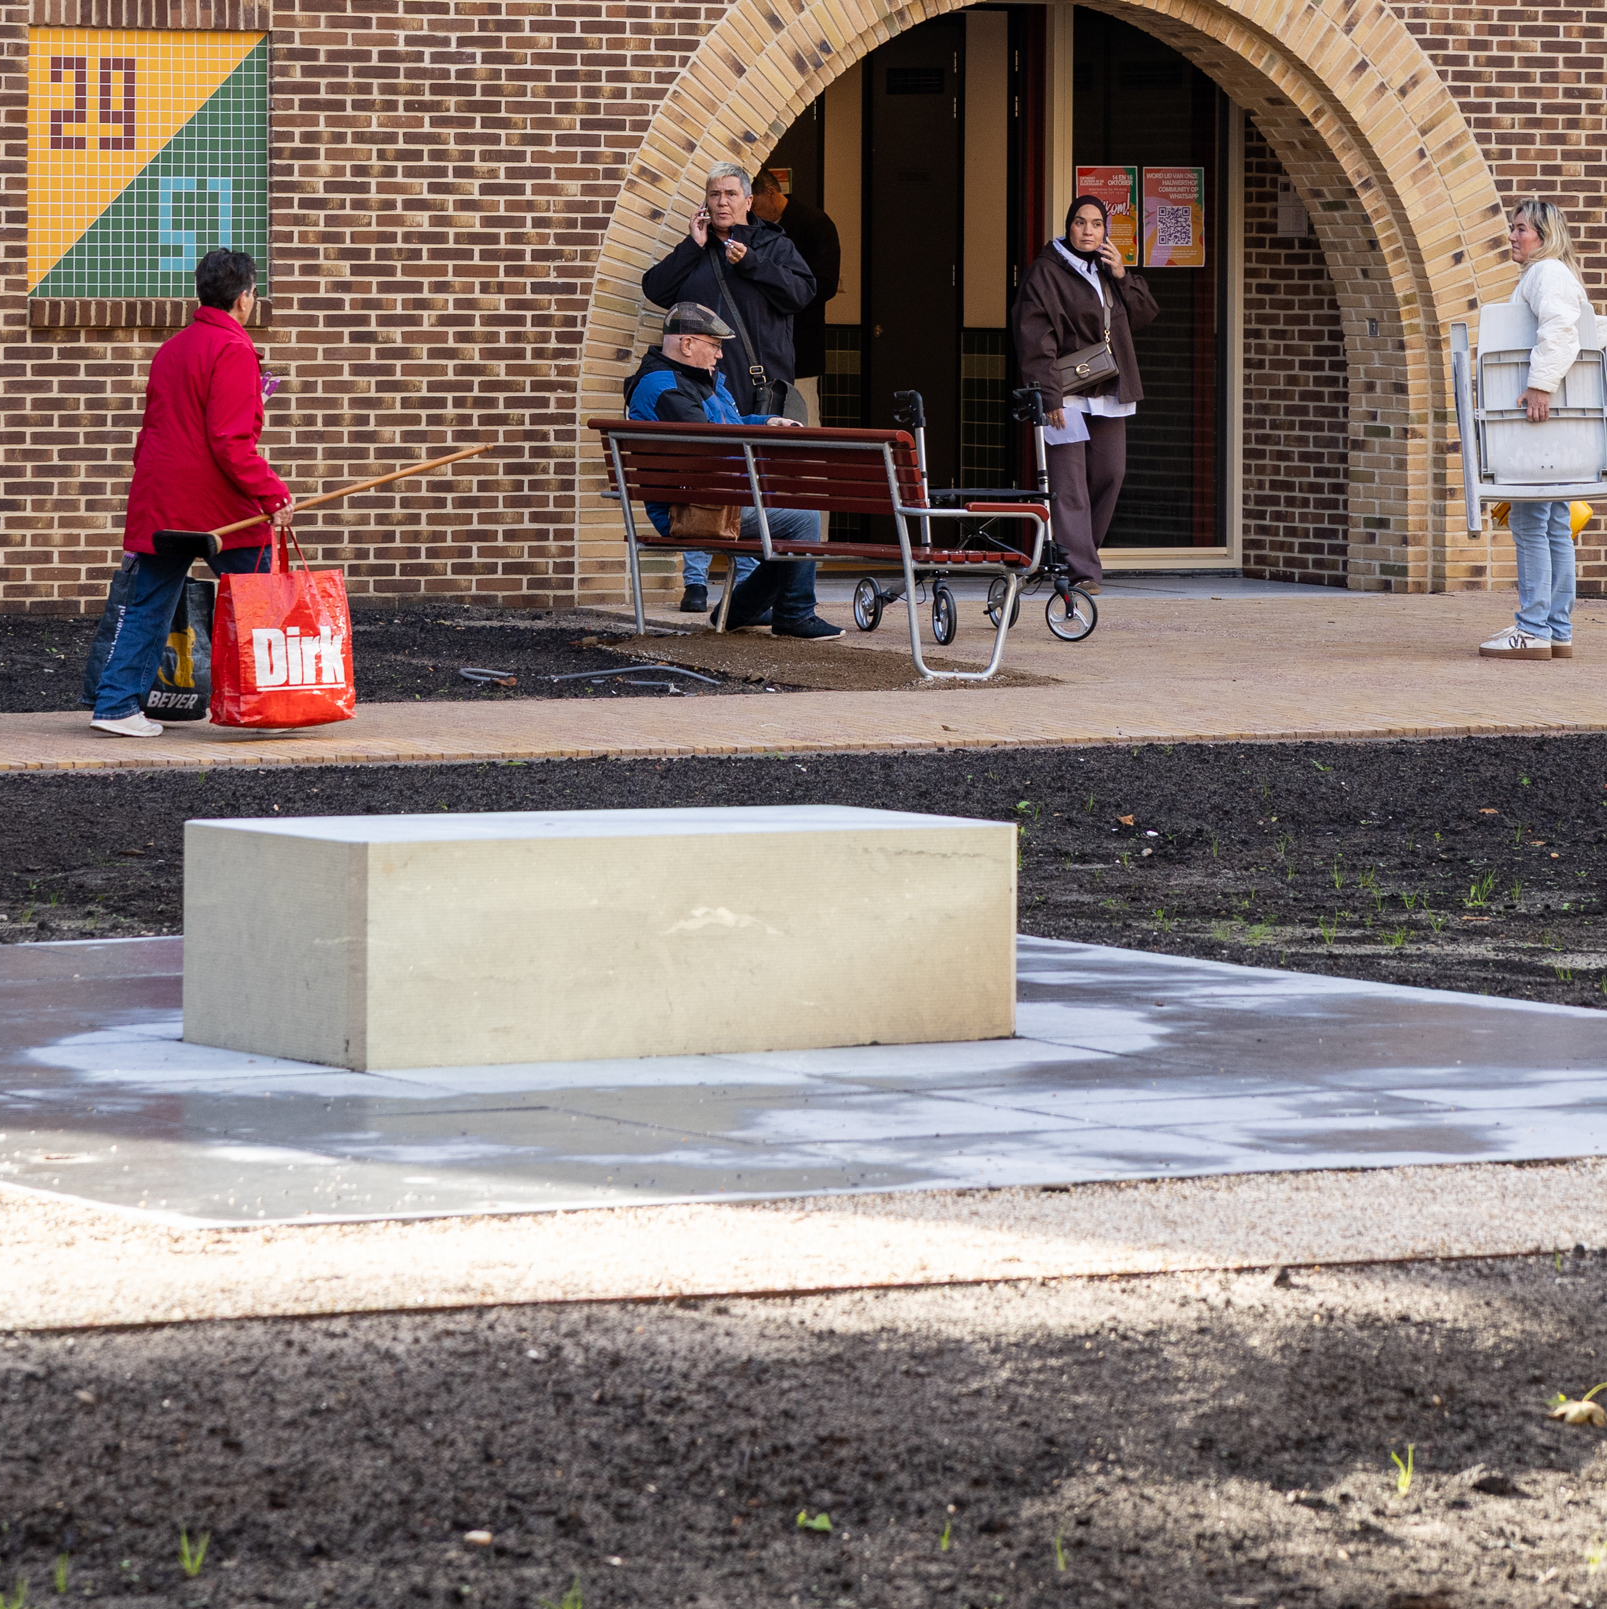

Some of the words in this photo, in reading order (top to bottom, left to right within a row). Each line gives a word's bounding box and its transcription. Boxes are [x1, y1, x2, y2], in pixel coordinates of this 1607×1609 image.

[50, 56, 136, 150] 29
[251, 625, 346, 687] Dirk
[147, 690, 198, 710] BEVER
